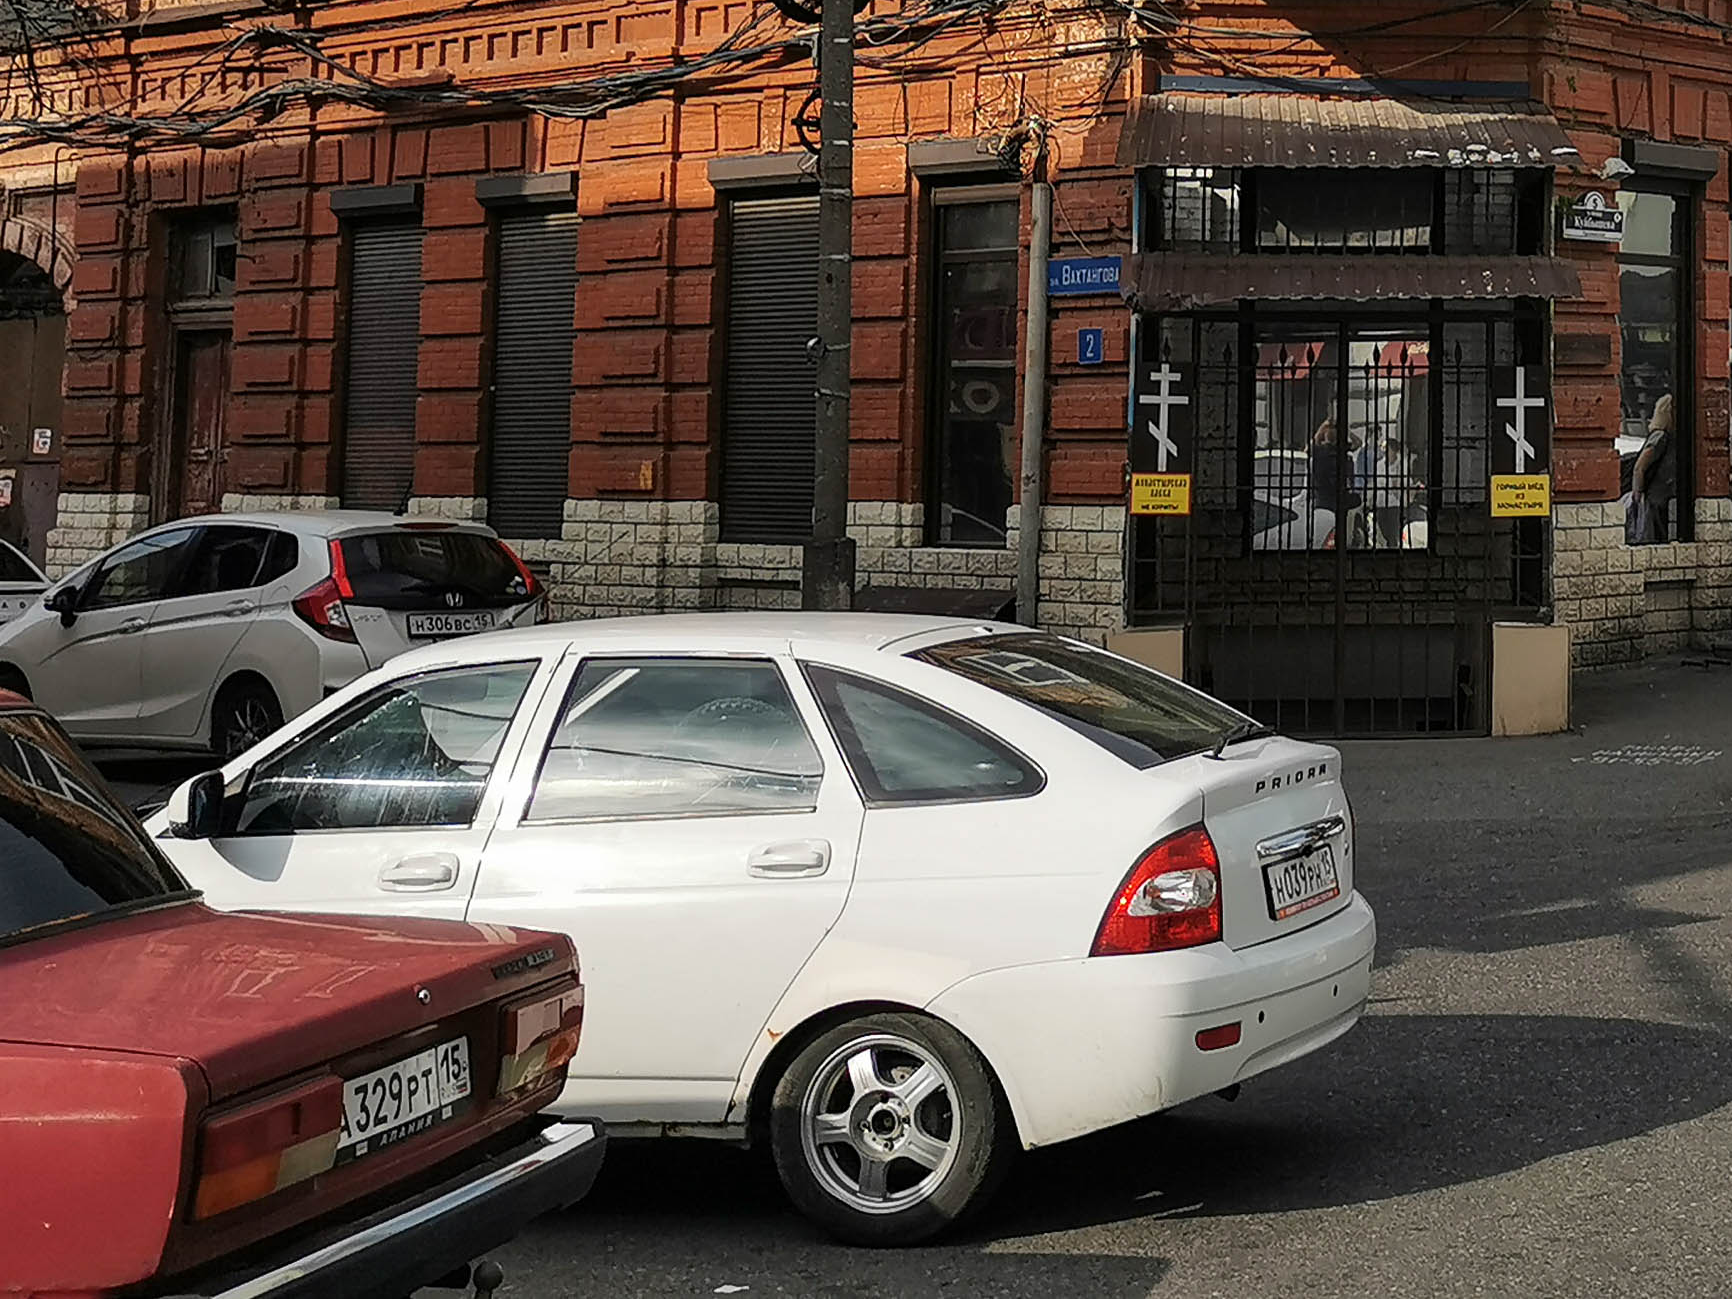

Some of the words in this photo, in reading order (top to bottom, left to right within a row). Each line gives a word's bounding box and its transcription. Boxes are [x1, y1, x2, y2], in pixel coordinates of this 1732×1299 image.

[1085, 333, 1095, 358] 2
[1255, 763, 1327, 794] PRIORA
[440, 1043, 462, 1084] 15
